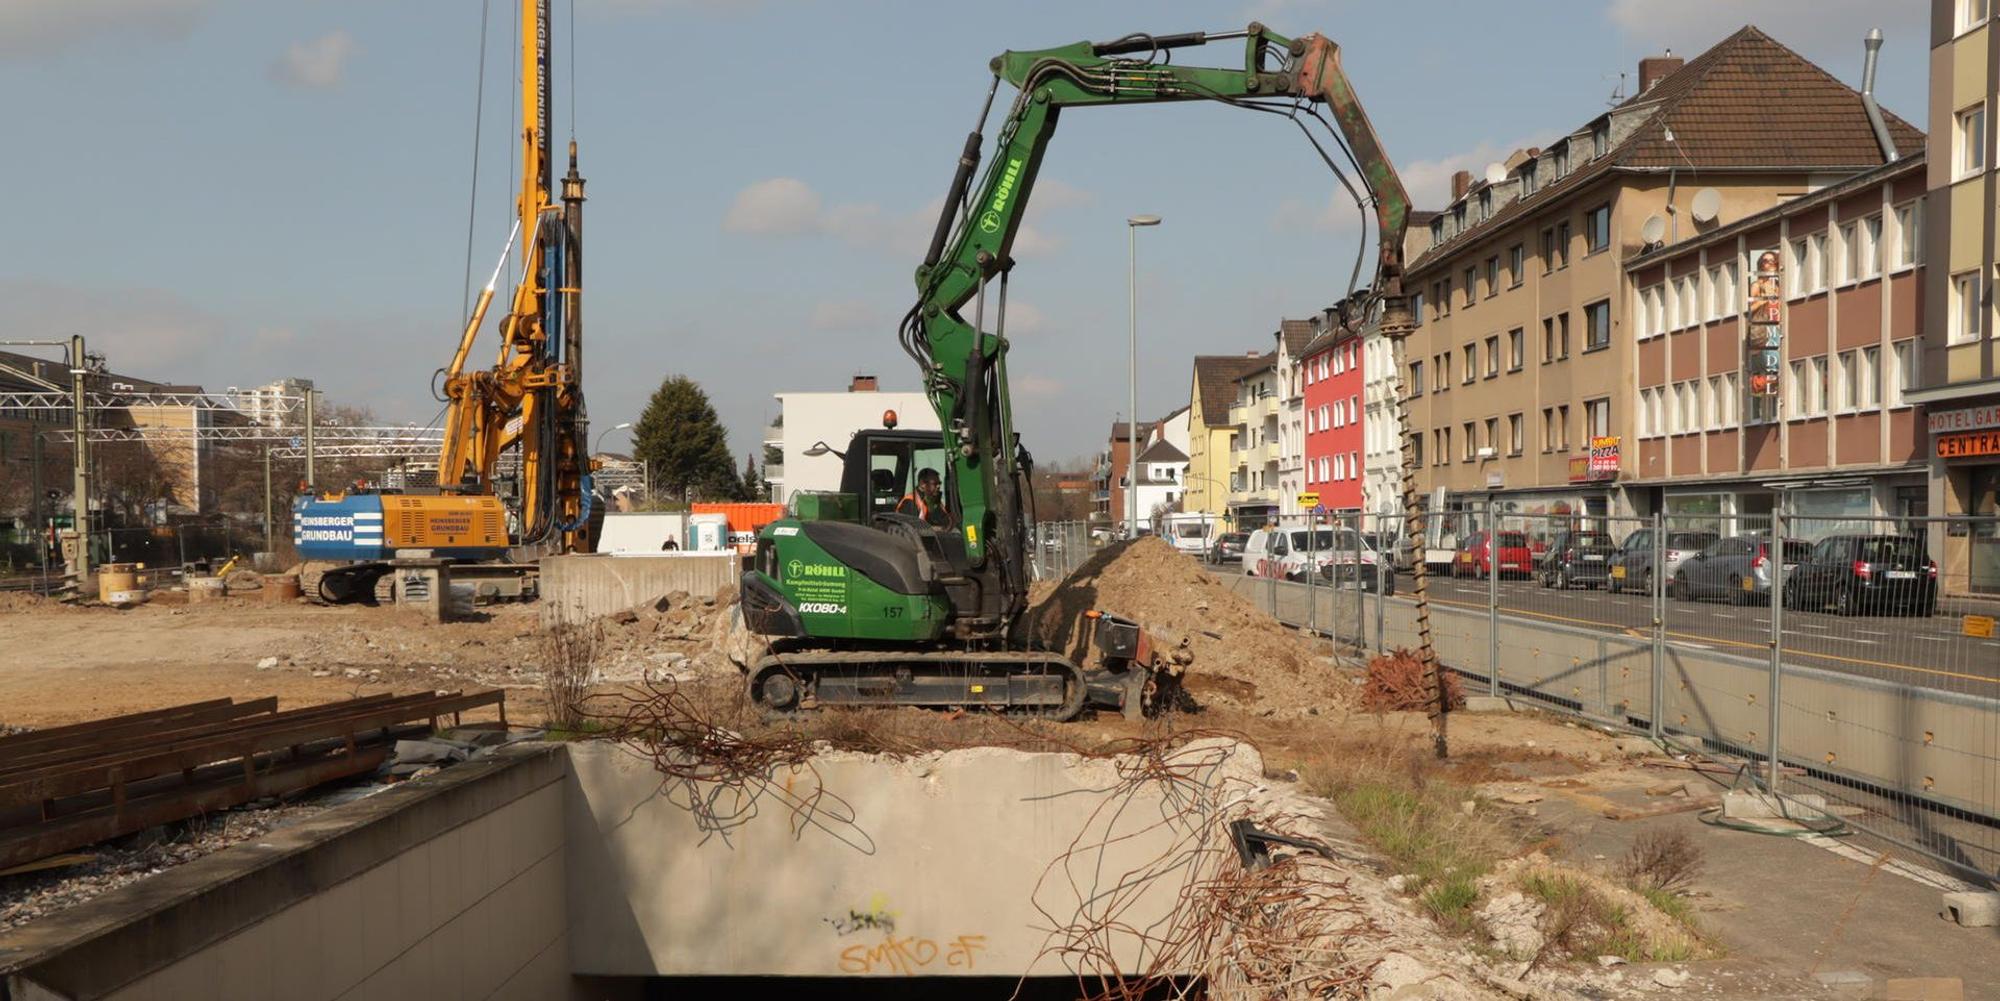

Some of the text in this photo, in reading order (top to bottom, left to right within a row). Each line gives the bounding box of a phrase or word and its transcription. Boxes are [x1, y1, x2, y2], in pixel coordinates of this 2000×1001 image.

[537, 64, 546, 149] GRUNDBAU
[992, 158, 1023, 213] RÖHLL
[1929, 411, 1970, 431] HOTEL
[1937, 433, 2000, 456] CENTRA
[1591, 445, 1619, 458] PIZZA
[301, 515, 354, 527] HEINSBERGER
[301, 530, 353, 542] GRUNDBAU
[727, 534, 757, 544] oels
[804, 564, 846, 577] RÖHLL
[798, 602, 847, 614] KX080-4
[883, 607, 904, 619] 157
